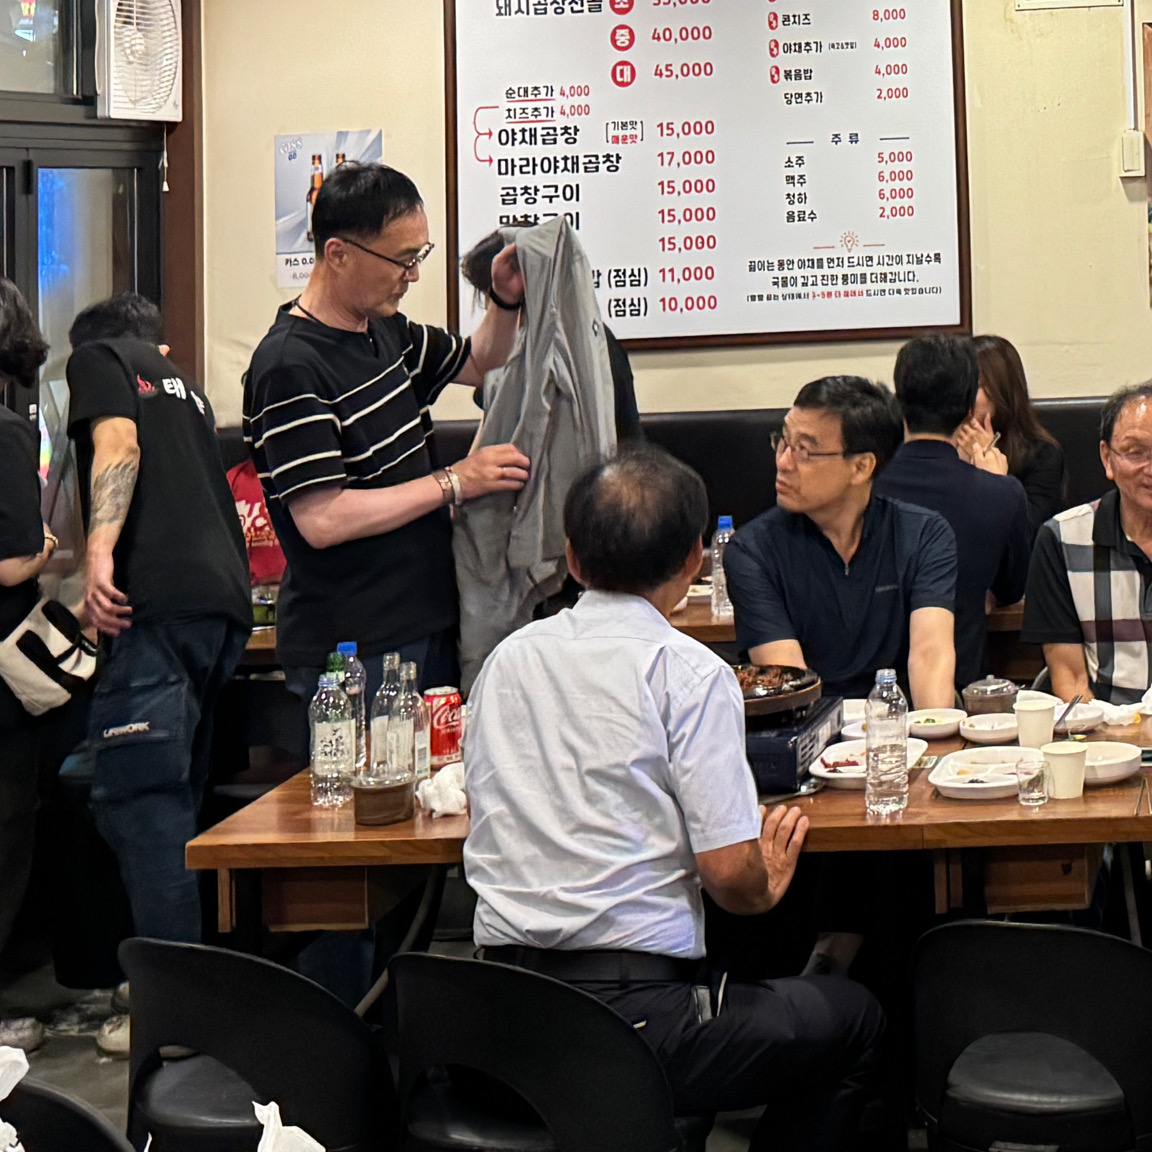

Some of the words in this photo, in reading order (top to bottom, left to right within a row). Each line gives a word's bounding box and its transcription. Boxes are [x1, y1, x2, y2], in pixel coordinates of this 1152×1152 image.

[781, 13, 811, 26] 콘치즈
[872, 8, 906, 23] 8,000
[615, 29, 630, 47] 중
[651, 25, 712, 44] 40,000
[782, 41, 823, 54] 야채추가
[874, 37, 907, 51] 4,000
[615, 65, 631, 83] 대
[653, 62, 714, 81] 45,000
[783, 68, 813, 82] 볶음밥
[875, 63, 908, 78] 4,000
[505, 86, 554, 99] 순대추가
[559, 85, 590, 99] 4,000
[784, 91, 823, 105] 당면추가
[876, 87, 909, 101] 2,000
[505, 106, 555, 120] 치즈추가
[560, 104, 590, 118] 4,000
[497, 125, 580, 147] 야채곱창
[656, 120, 715, 138] 15,000
[497, 153, 622, 177] 마라야채곱창
[657, 149, 716, 168] 17,000
[784, 155, 805, 168] 소주
[877, 151, 913, 165] 5,000
[785, 174, 807, 187] 맥주
[878, 170, 913, 184] 6,000
[499, 183, 581, 206] 곱창구이
[657, 178, 716, 198] 15,000
[785, 192, 807, 205] 청하
[878, 188, 914, 202] 6,000
[658, 206, 716, 225] 15,000
[786, 209, 817, 223] 음료수
[879, 206, 914, 220] 2,000
[658, 235, 717, 254] 15,000
[285, 258, 300, 267] 카스
[748, 259, 775, 272] 끓이는
[777, 259, 795, 272] 동안
[797, 258, 824, 270] 야채를
[826, 256, 844, 269] 먼저
[847, 255, 874, 268] 드시면
[876, 254, 904, 267] 시간이
[607, 267, 648, 289] (점심)
[659, 265, 715, 284] 11,000
[772, 276, 798, 289] 국물이
[801, 275, 818, 287] 깊고
[820, 274, 838, 287] 진한
[842, 273, 867, 286] 풍미를
[607, 297, 648, 319] (점심)
[659, 295, 717, 314] 10,000
